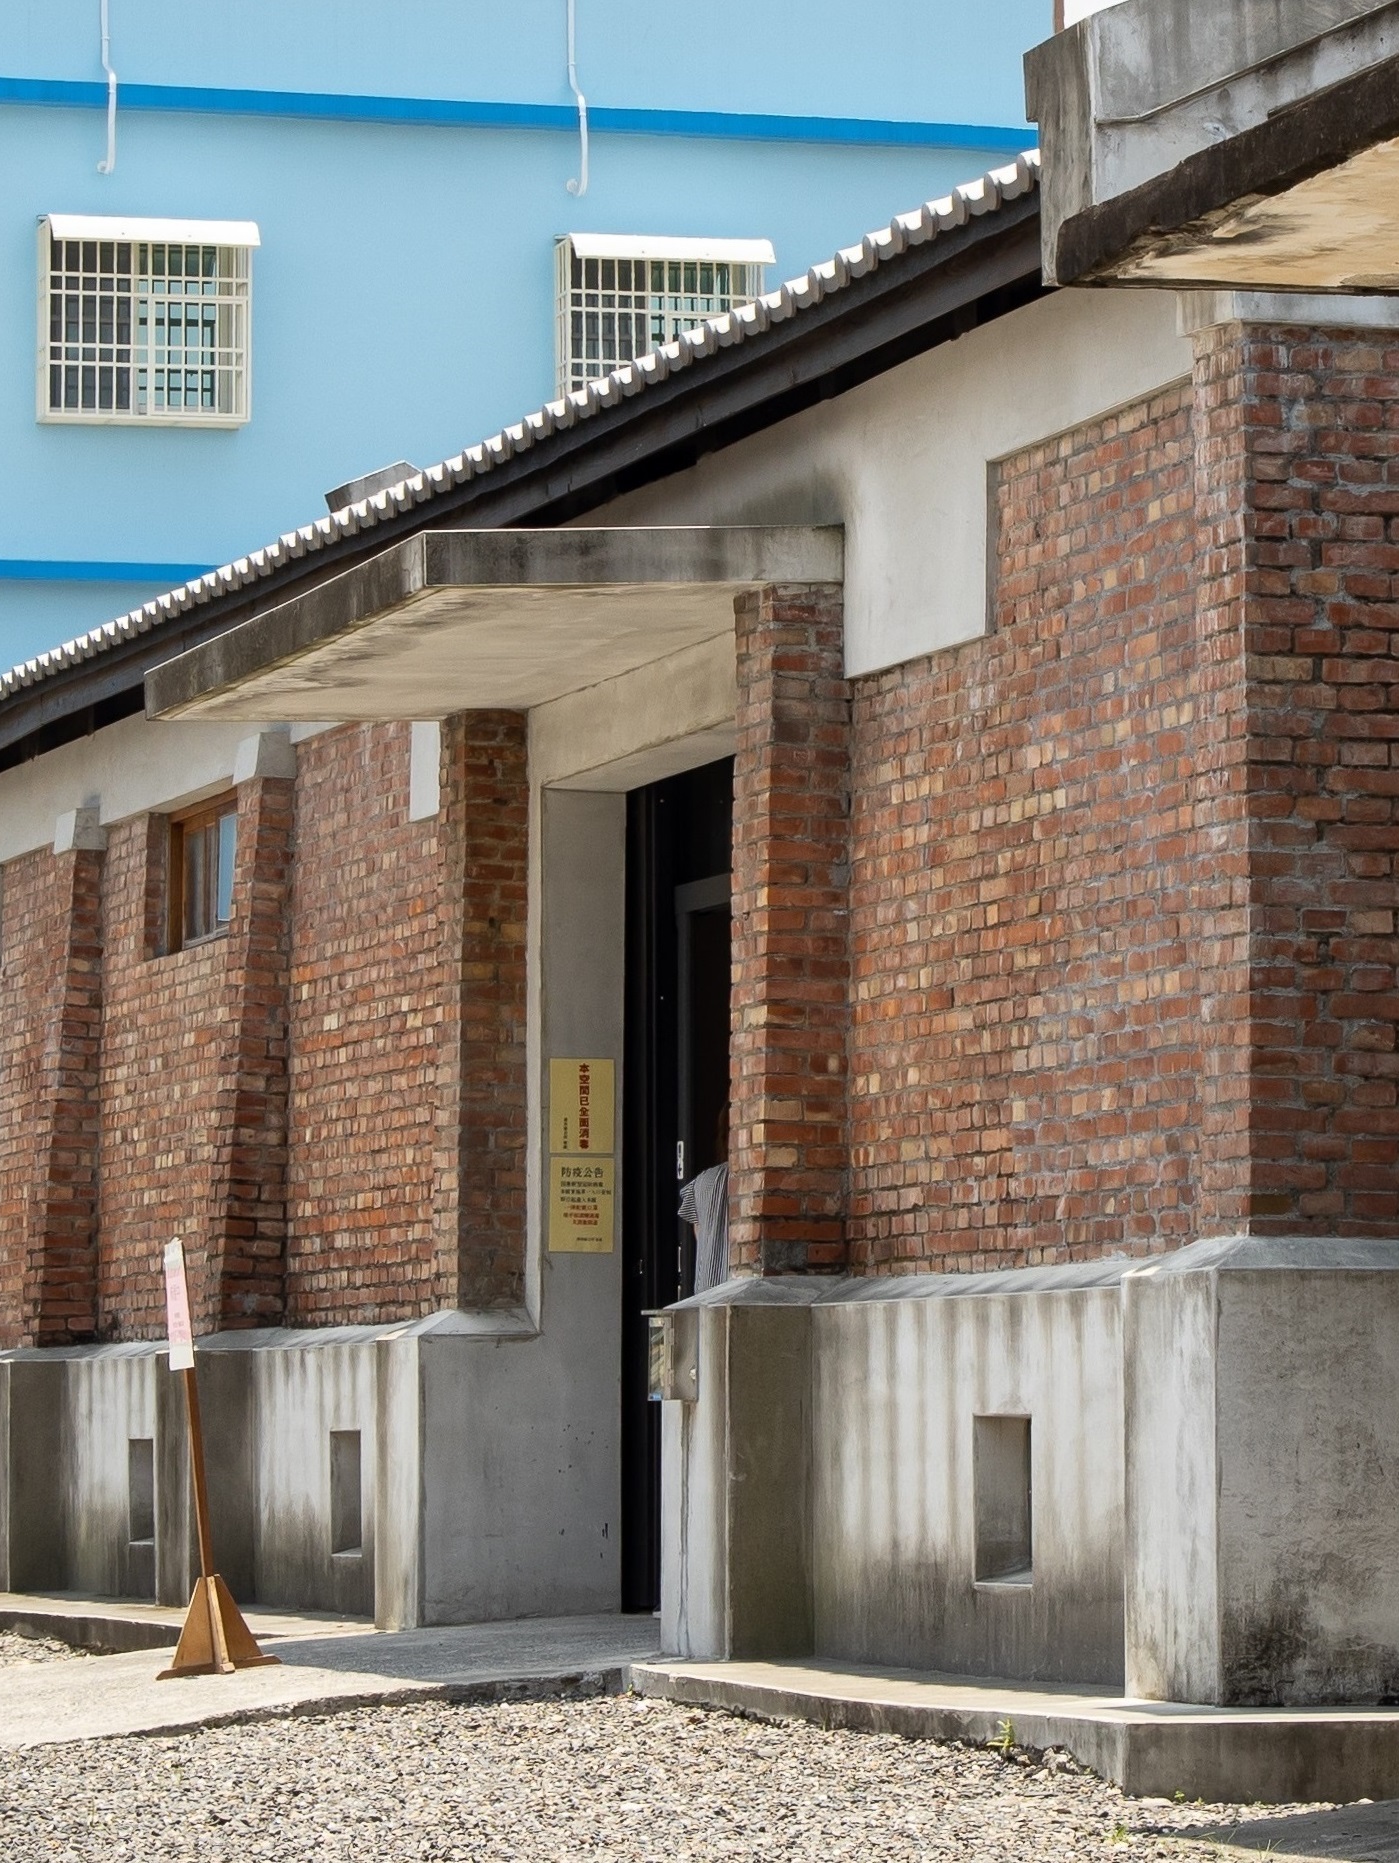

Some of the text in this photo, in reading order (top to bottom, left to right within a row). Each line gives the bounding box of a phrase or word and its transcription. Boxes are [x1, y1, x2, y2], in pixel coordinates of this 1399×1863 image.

[579, 1063, 590, 1149] 本空間已全面消毒
[561, 1166, 604, 1178] 防疫公告
